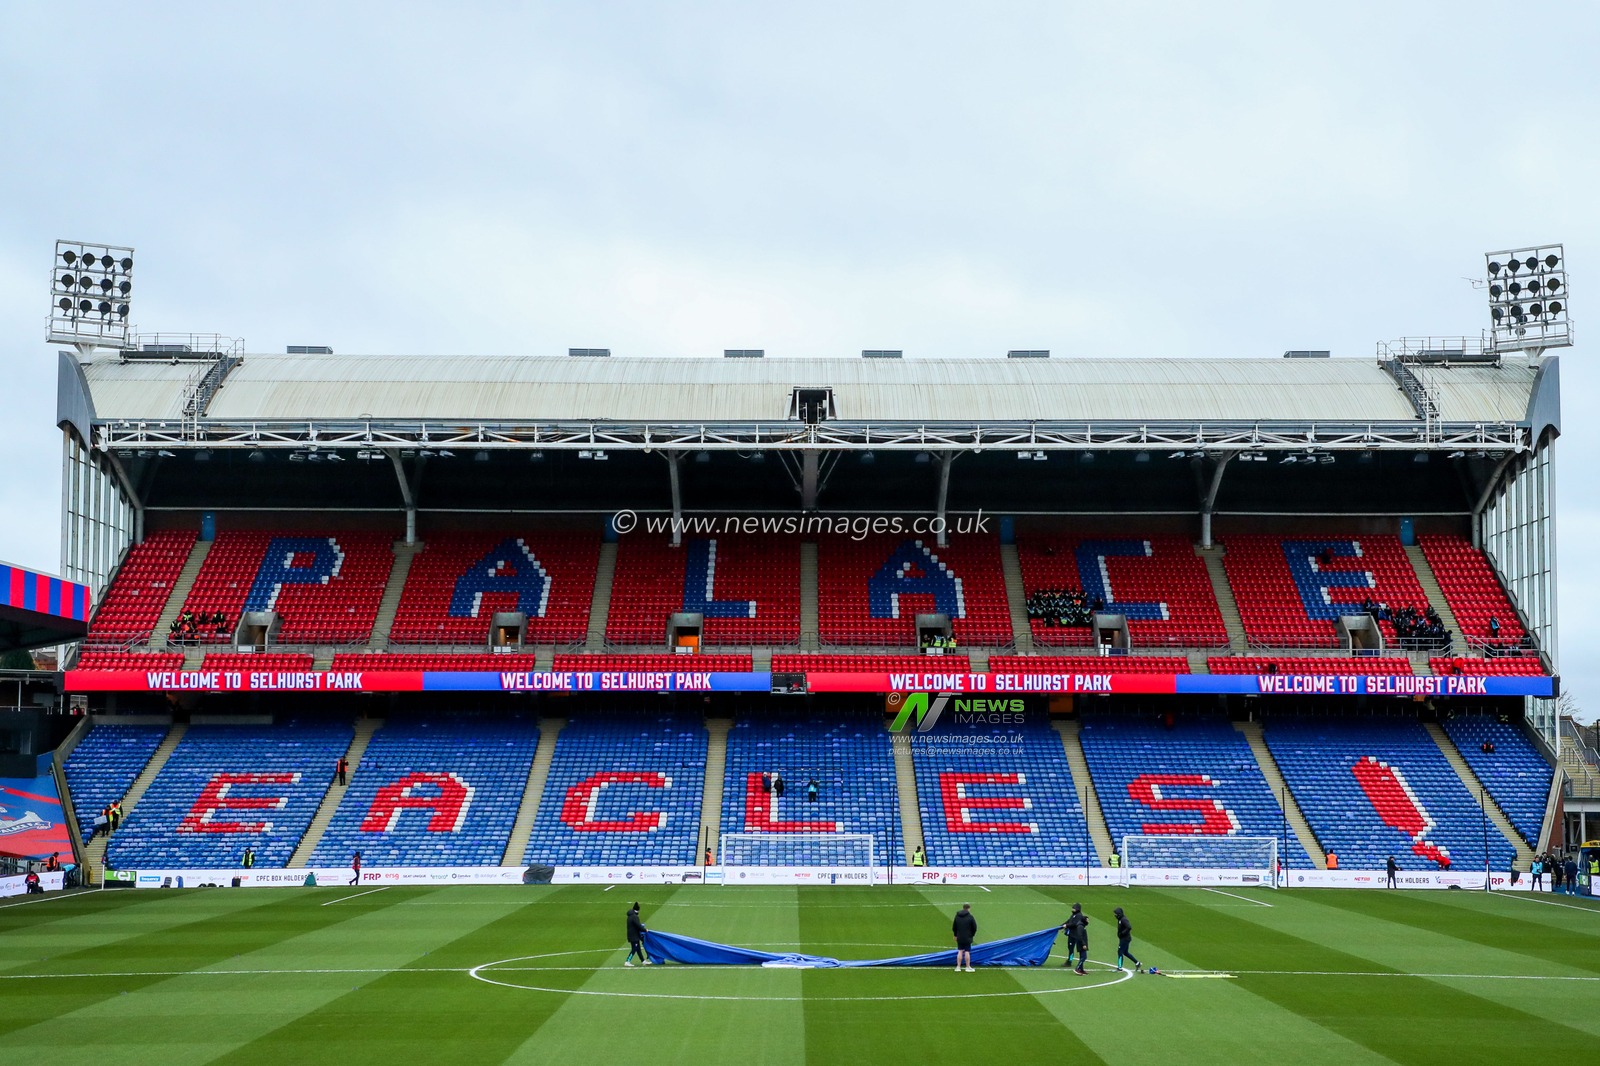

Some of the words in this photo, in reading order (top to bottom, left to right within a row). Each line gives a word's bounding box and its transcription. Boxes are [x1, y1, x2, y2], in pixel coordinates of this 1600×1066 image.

[147, 672, 220, 689] WELCOME
[224, 672, 241, 689] TO
[250, 672, 322, 689] SELHURST
[326, 672, 363, 689] PARK
[500, 672, 572, 689] WELCOME
[576, 672, 593, 689] TO
[601, 672, 672, 689] SELHURST
[676, 672, 712, 689] PARK
[889, 673, 964, 690] WELCOME
[969, 674, 986, 690] TO
[995, 674, 1069, 690] SELHURST
[1074, 675, 1112, 691] PARK
[1258, 675, 1335, 692] WELCOME
[1339, 676, 1357, 692] TO
[1366, 676, 1443, 693] SELHURST
[1448, 677, 1487, 693] PARK
[271, 874, 283, 882] BOX
[283, 873, 307, 882] HOLDERS
[363, 873, 381, 881] FRP
[385, 873, 400, 881] ersg
[922, 872, 940, 880] FRP
[943, 872, 958, 880] ersg
[1488, 877, 1504, 885] RP
